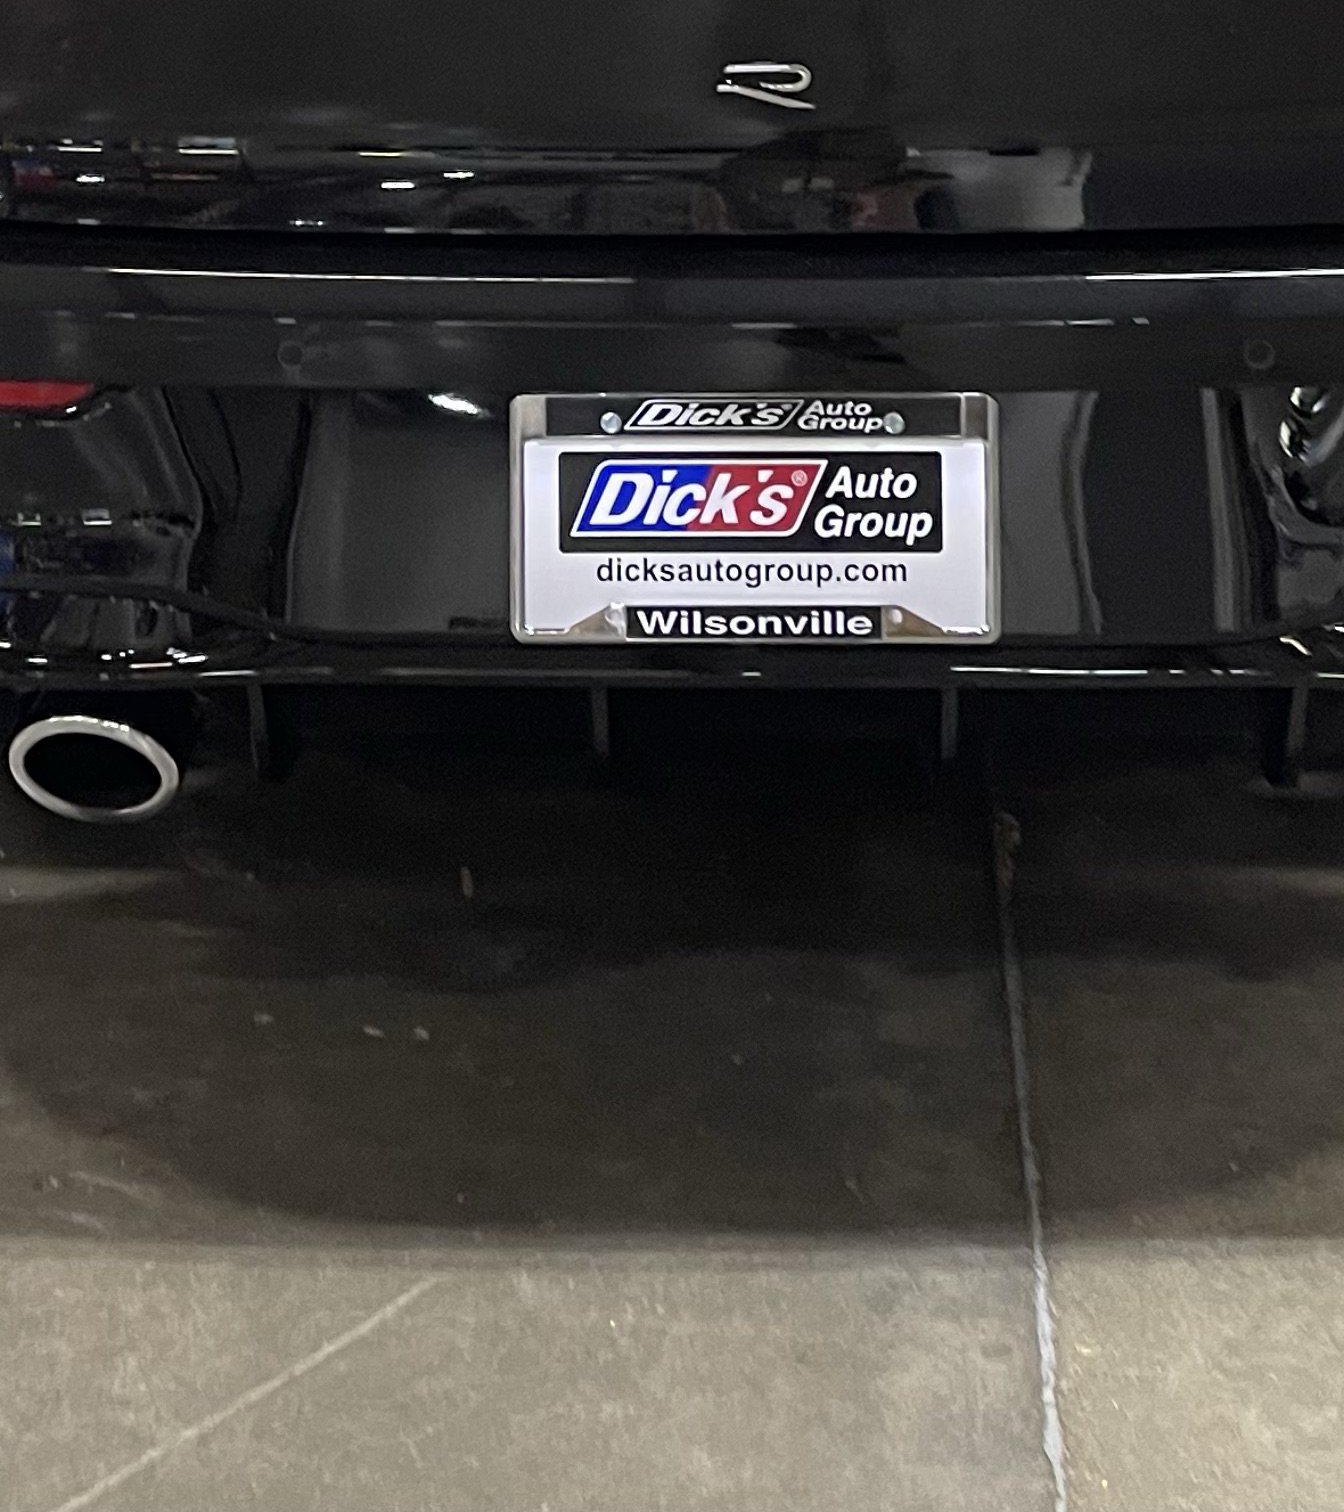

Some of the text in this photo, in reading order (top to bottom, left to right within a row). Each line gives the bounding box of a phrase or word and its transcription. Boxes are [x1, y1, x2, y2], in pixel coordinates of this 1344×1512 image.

[715, 61, 817, 110] R
[636, 402, 792, 427] Dick's
[804, 399, 873, 417] Auto
[797, 414, 884, 433] Group
[824, 465, 918, 500] Auto
[813, 503, 934, 547] Group
[596, 557, 908, 588] dicksautogroup.com
[636, 609, 875, 637] Wilsonville
